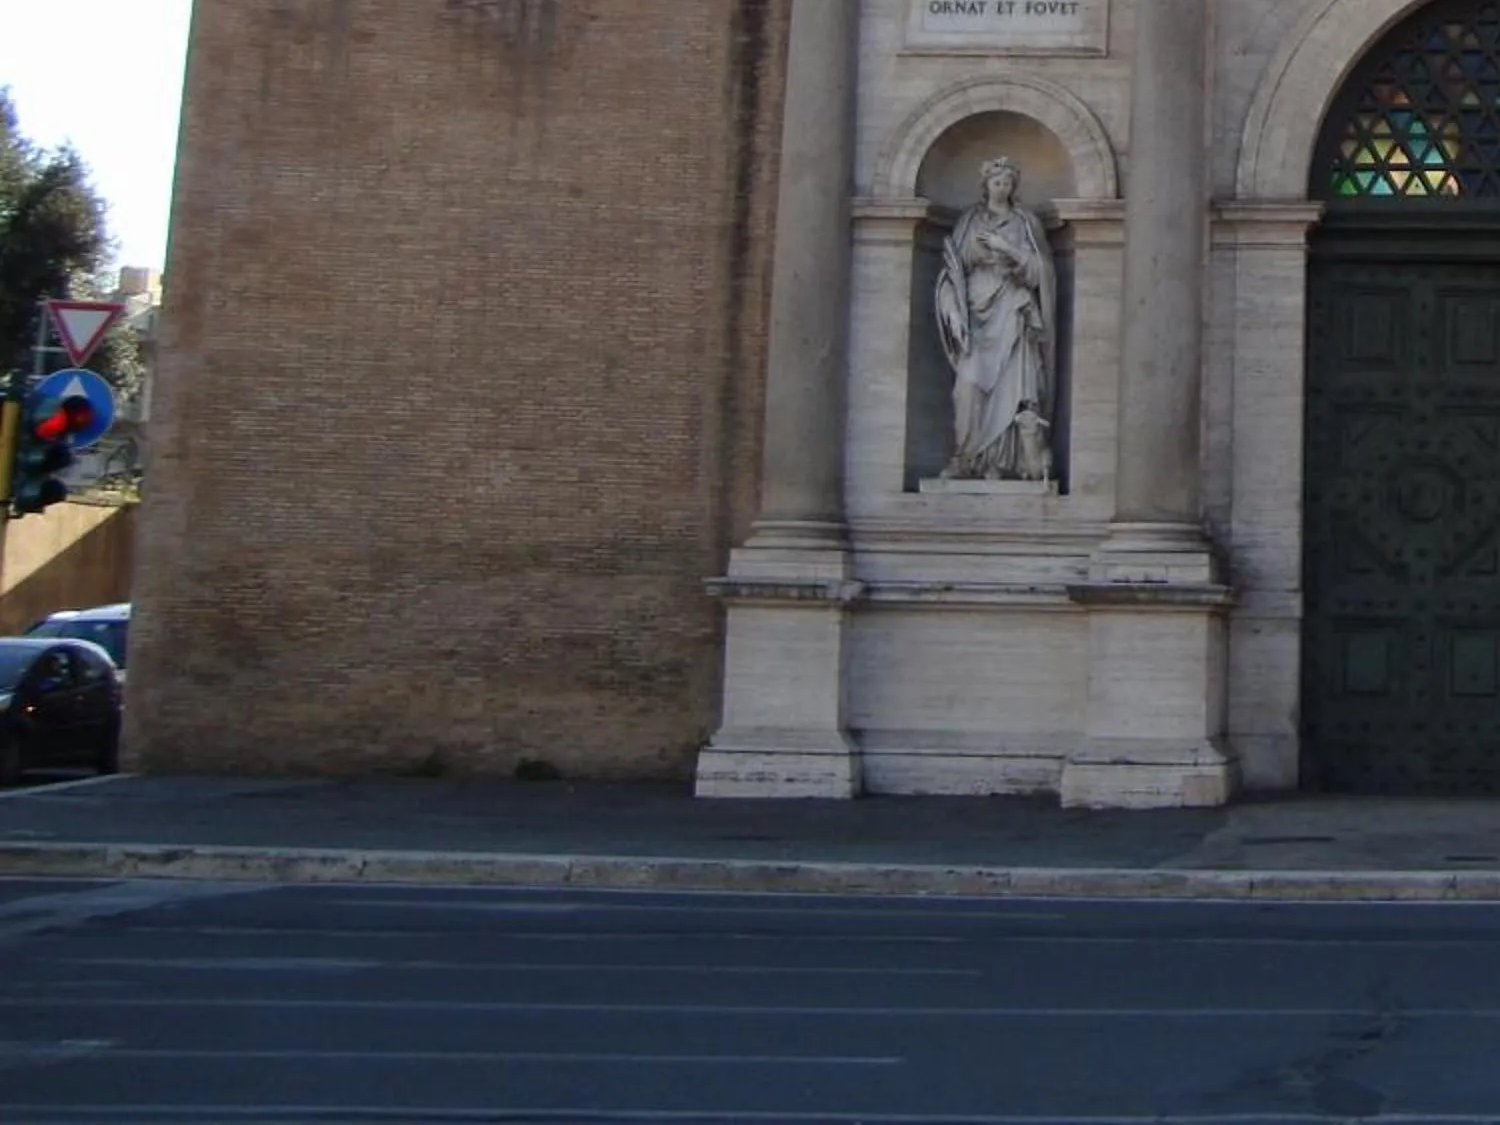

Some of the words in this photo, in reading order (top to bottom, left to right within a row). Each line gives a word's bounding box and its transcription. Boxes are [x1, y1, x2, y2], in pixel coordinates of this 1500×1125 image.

[929, 0, 988, 16] ORNAT
[996, 0, 1016, 16] ET
[1025, 0, 1079, 16] FOVET
